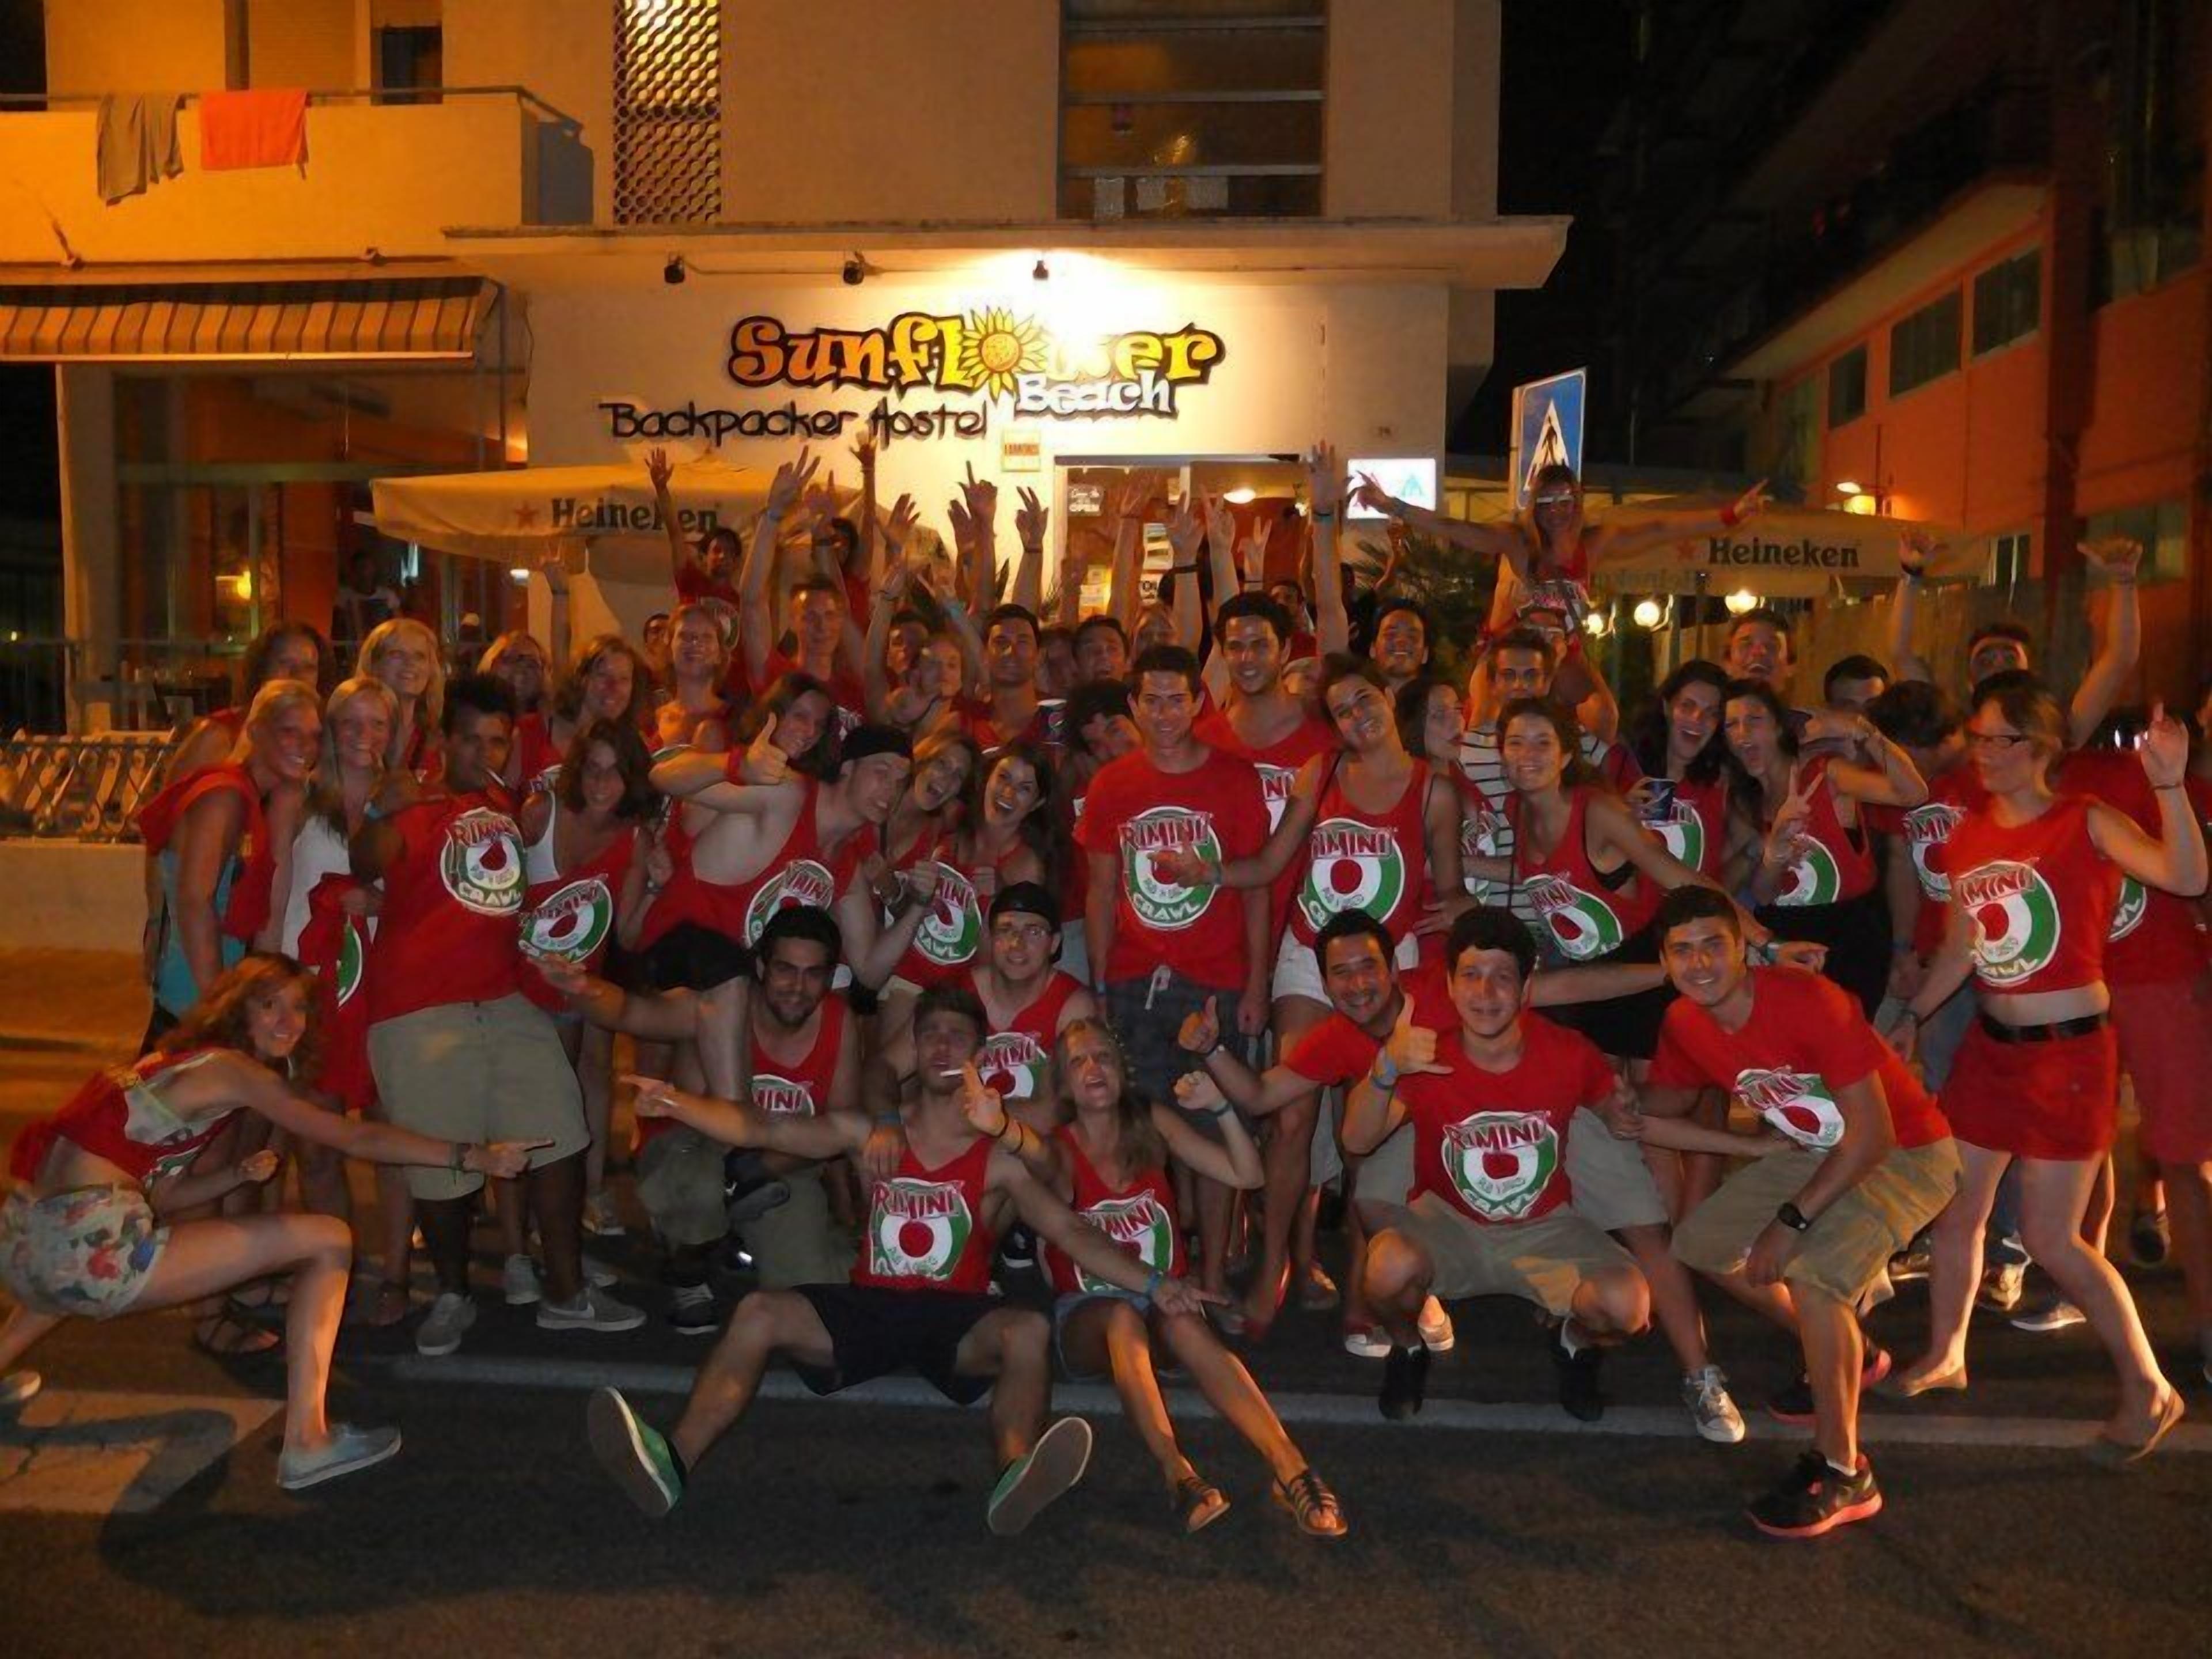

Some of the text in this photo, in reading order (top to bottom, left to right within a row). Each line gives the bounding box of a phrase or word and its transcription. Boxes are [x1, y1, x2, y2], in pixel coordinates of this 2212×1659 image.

[1015, 368, 1176, 419] Beach
[599, 396, 987, 450] Backpacker Hostel
[1707, 536, 1860, 567] Heineken
[1955, 867, 2035, 908] IMINI
[1132, 892, 1200, 920] CRAWL
[916, 922, 961, 957] AWL
[978, 1039, 1036, 1073] MINI
[1445, 1116, 1546, 1152] RIMINI
[869, 1181, 960, 1220] RIMINI
